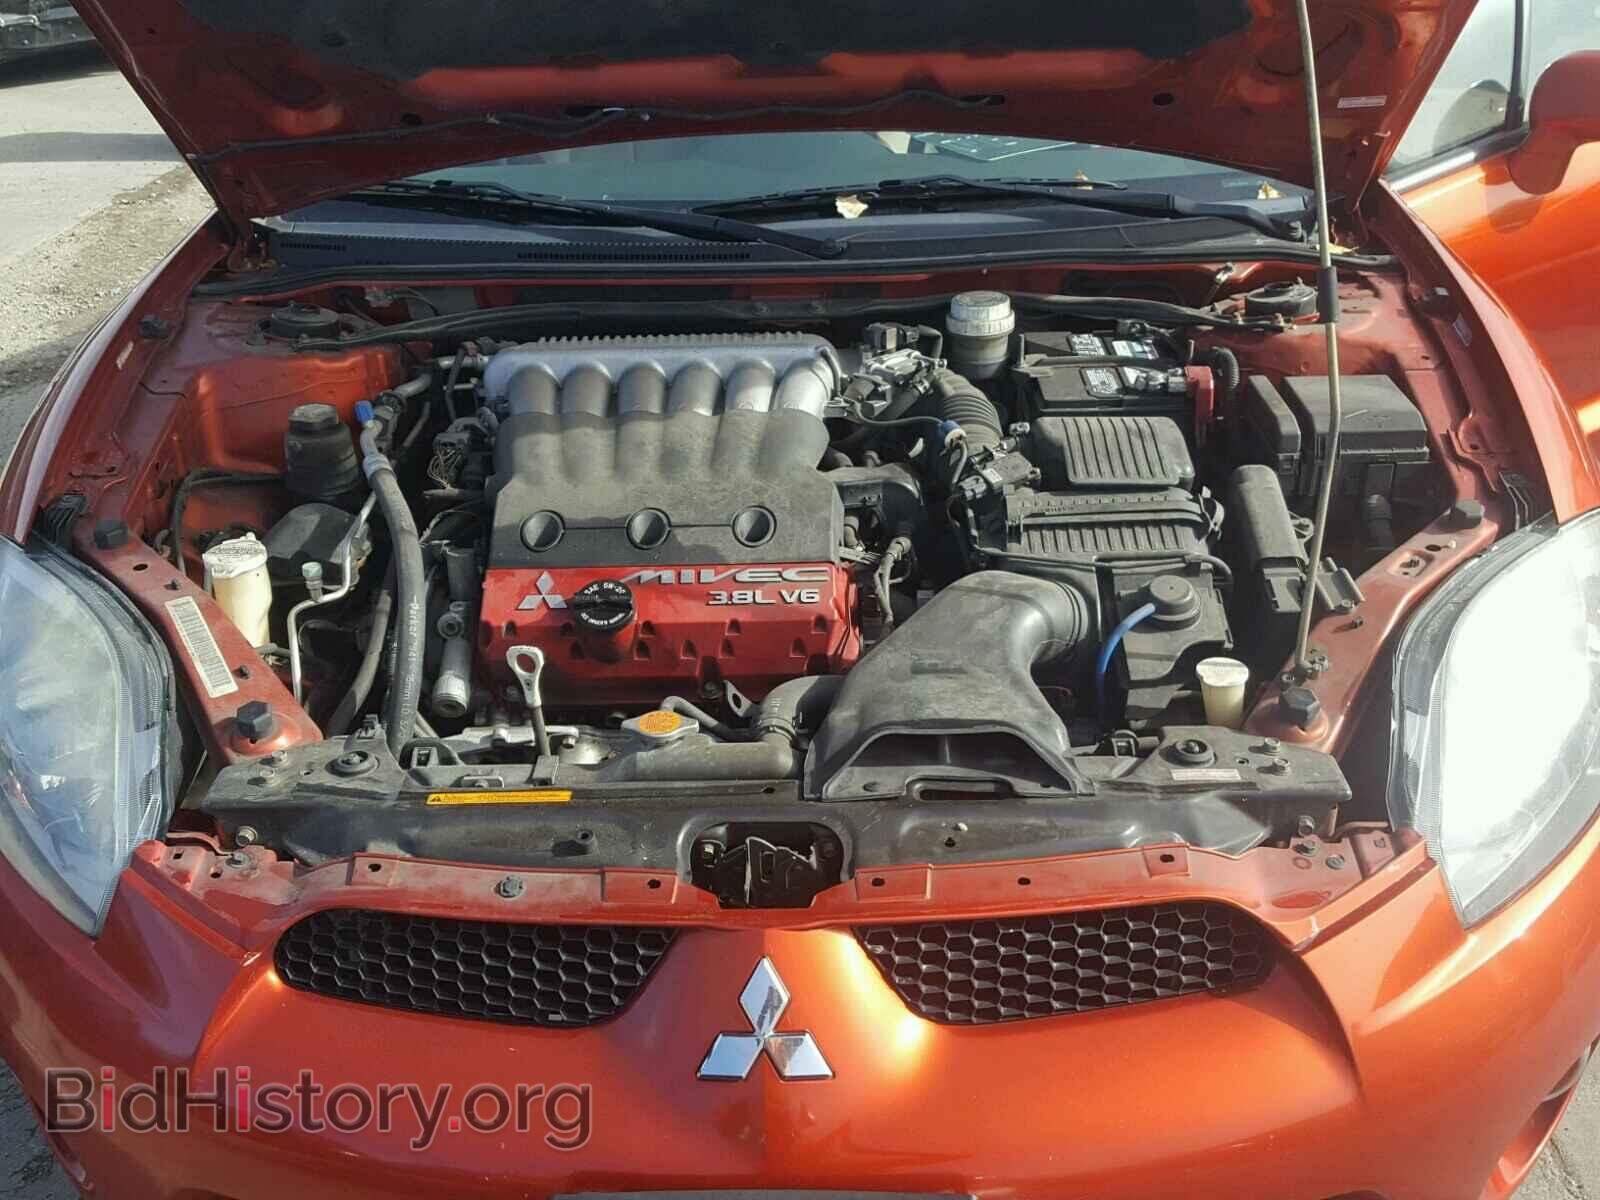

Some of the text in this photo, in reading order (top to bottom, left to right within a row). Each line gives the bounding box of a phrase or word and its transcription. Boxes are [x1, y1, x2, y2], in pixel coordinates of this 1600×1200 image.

[619, 567, 830, 584] MIVEC
[707, 588, 820, 605] 3.8L V6
